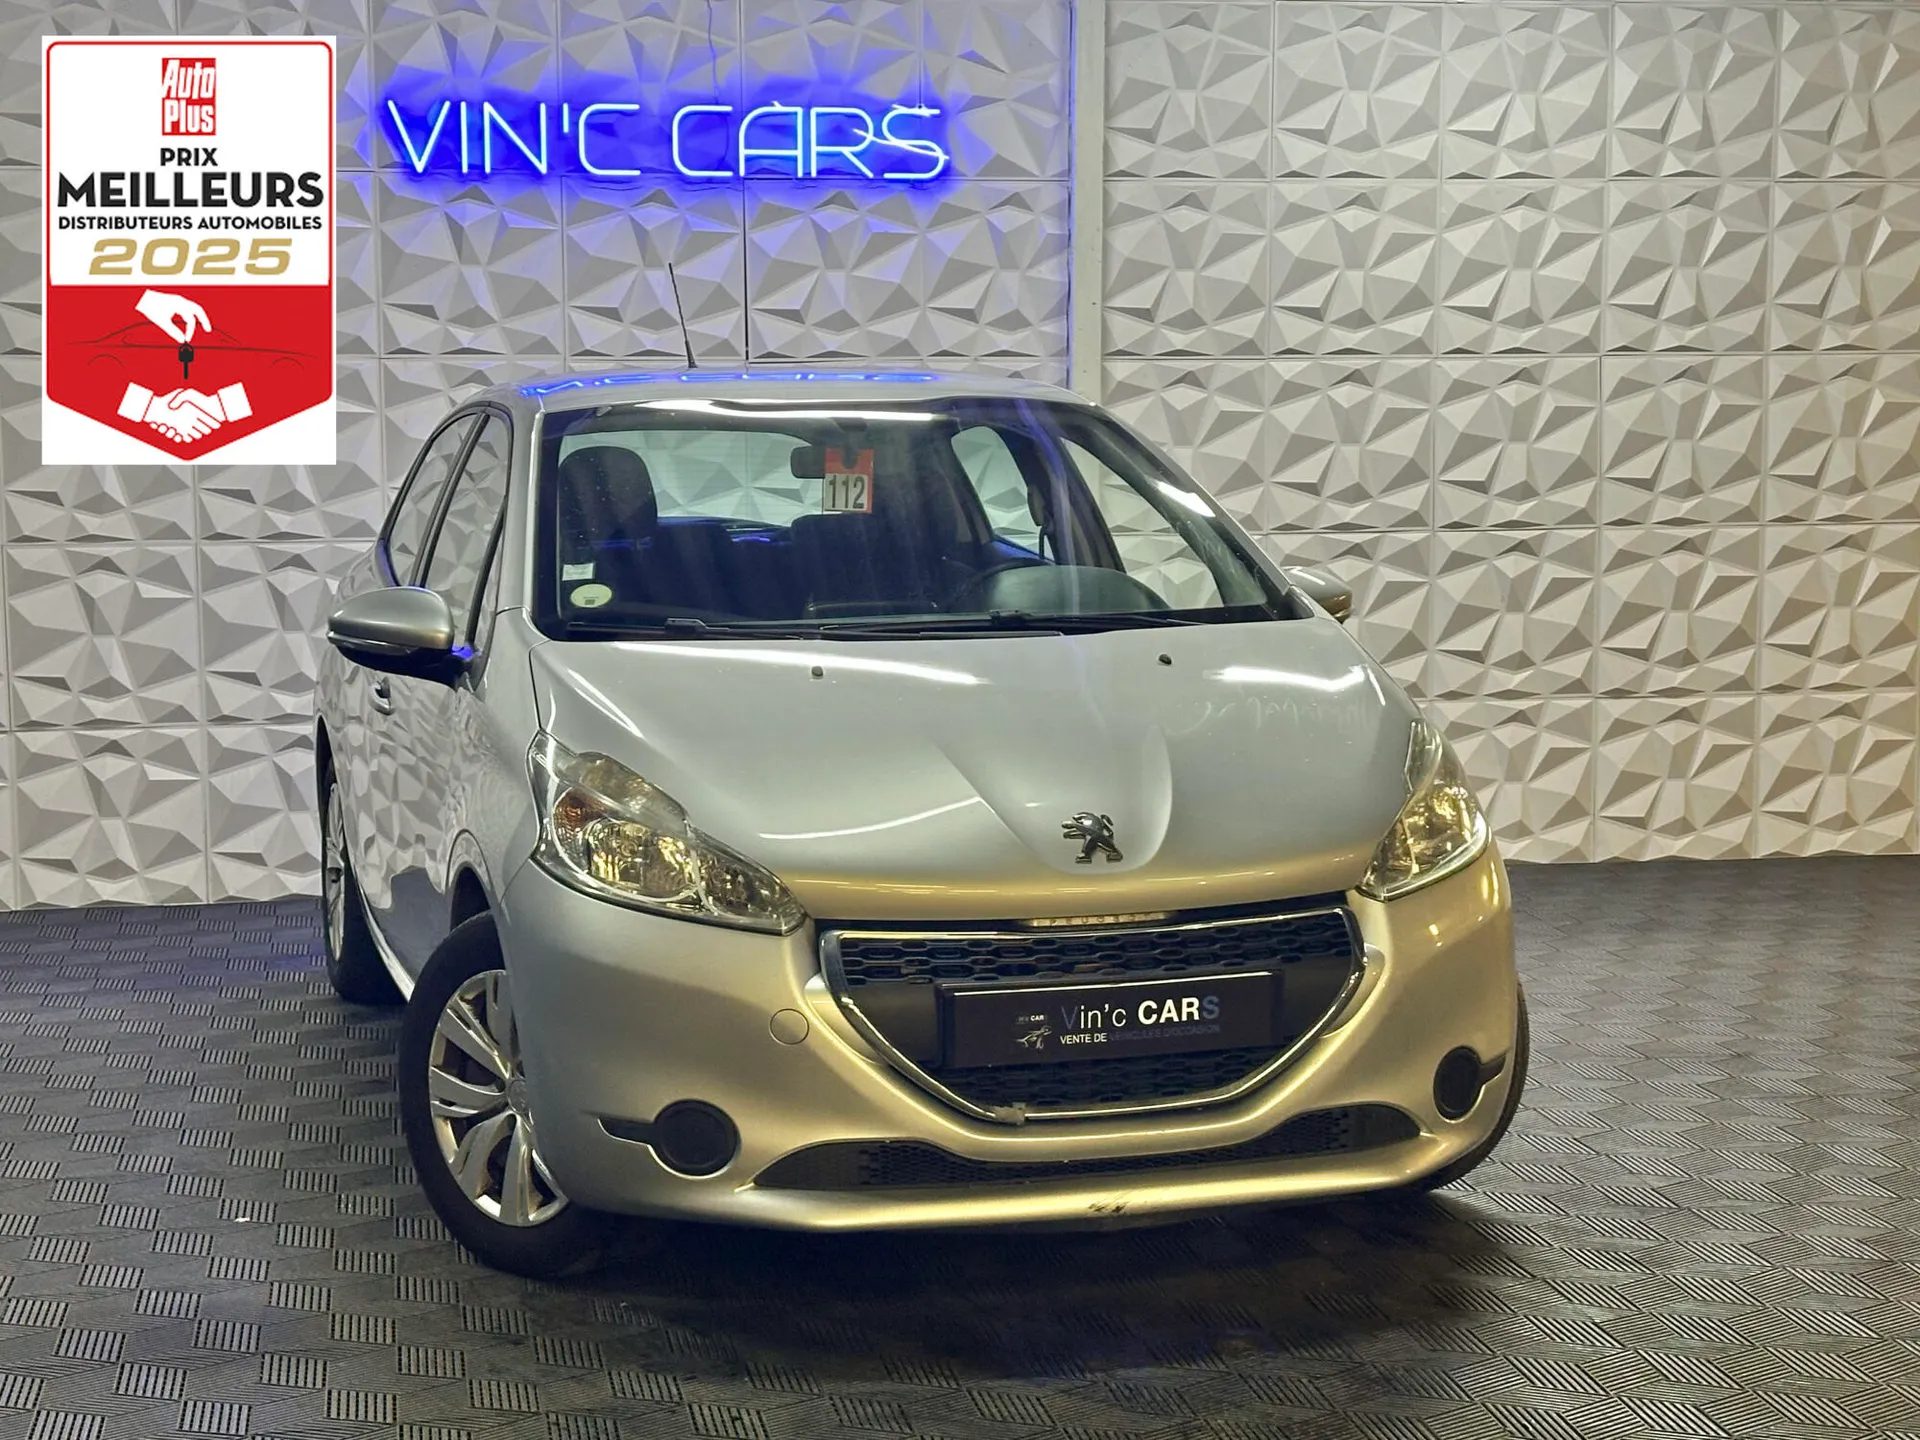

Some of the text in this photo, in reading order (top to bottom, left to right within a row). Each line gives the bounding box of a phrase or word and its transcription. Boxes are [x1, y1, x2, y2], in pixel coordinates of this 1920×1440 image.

[387, 99, 949, 179] VIN'C CARS
[828, 474, 865, 509] 112
[1060, 995, 1220, 1031] Vin'c CARS
[1060, 1034, 1092, 1045] VENTE
[1093, 1032, 1108, 1043] DE
